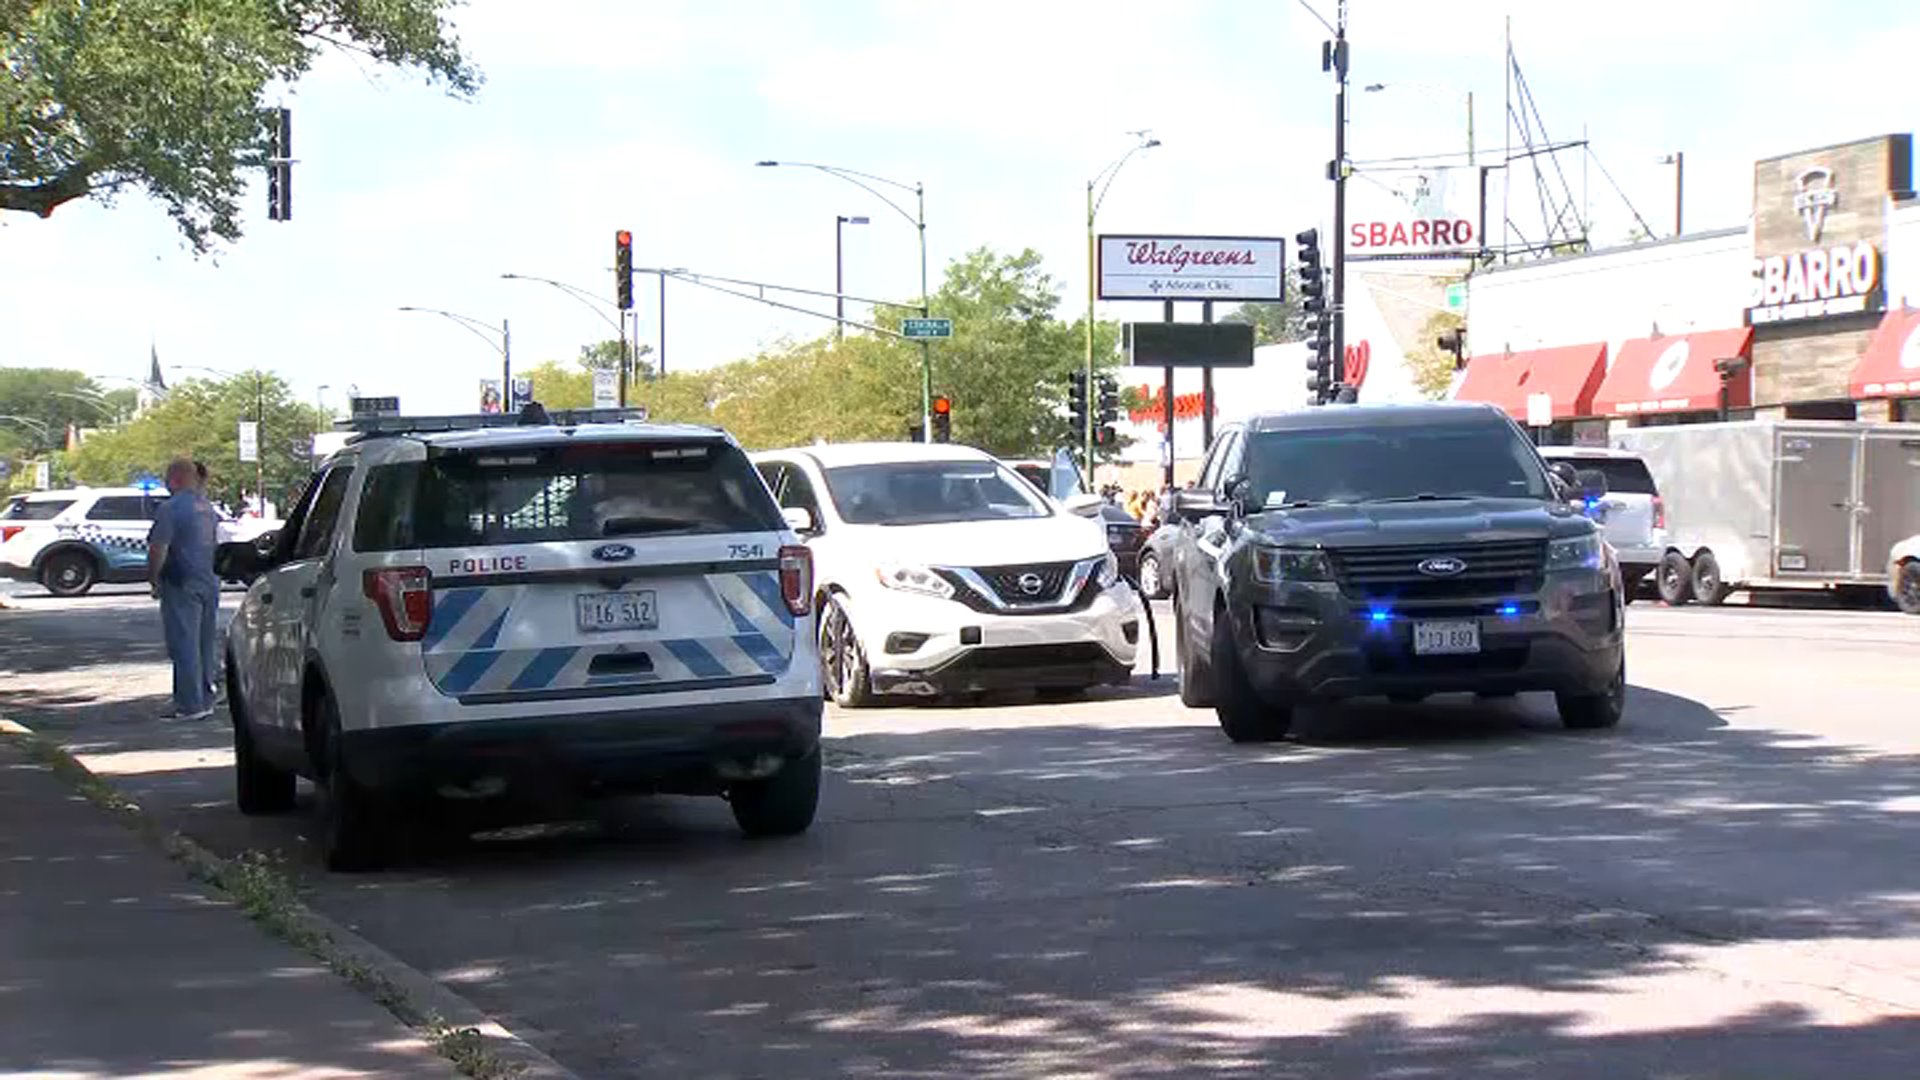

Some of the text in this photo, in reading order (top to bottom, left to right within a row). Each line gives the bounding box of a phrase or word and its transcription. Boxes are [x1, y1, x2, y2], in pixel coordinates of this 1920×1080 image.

[1350, 219, 1473, 248] SBARRO
[1126, 241, 1257, 273] Walgreens
[1751, 242, 1877, 304] SBARRO
[449, 555, 527, 574] POLICE
